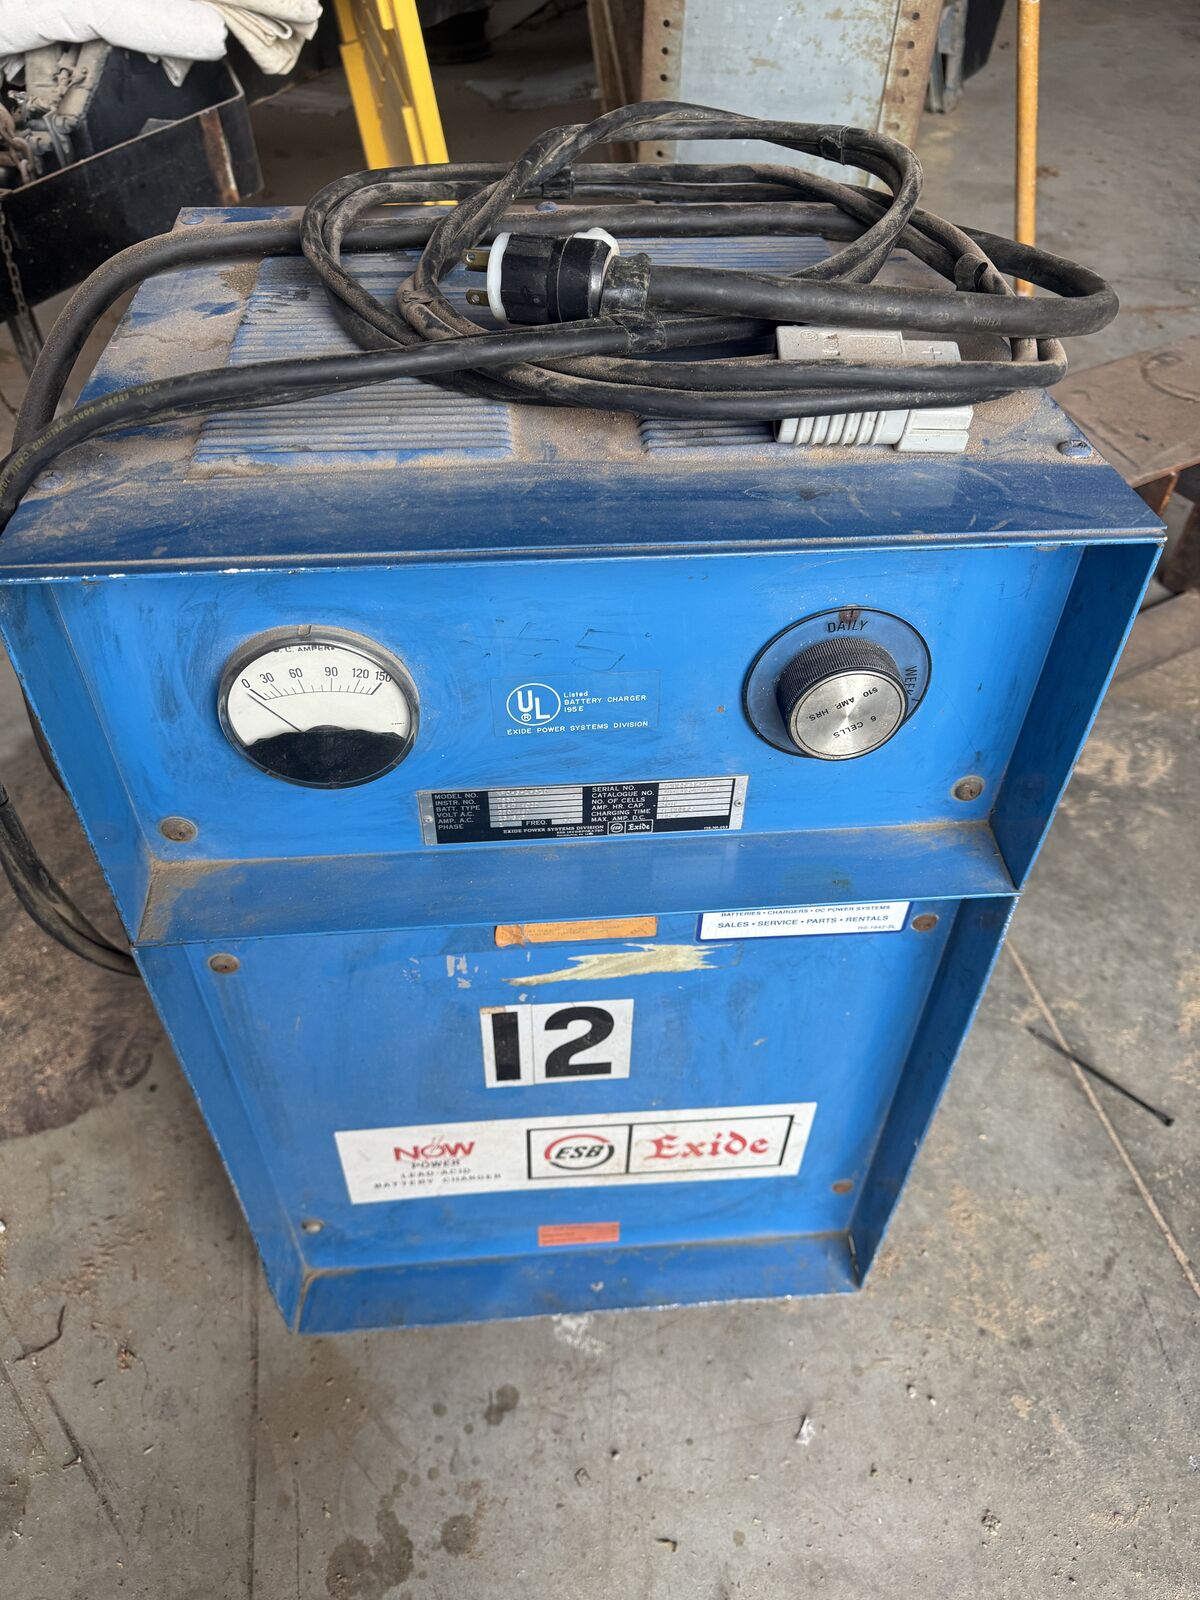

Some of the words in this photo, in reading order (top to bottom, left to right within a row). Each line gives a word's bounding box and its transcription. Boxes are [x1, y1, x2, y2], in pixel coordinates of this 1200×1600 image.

[827, 619, 869, 633] DAILY
[259, 672, 275, 684] 30
[288, 667, 303, 678] 60
[324, 666, 339, 677] 90
[352, 667, 370, 679] 120
[375, 671, 392, 683] 150
[241, 678, 251, 689] 0
[516, 690, 551, 720] UL
[564, 697, 602, 705] BATTERY
[607, 694, 647, 703] CHARGER
[835, 696, 855, 710] AMP.
[806, 709, 830, 722] HRS.
[507, 728, 532, 736] EXIDE
[536, 726, 566, 734] POWER
[570, 723, 609, 731] SYSTEMS
[613, 720, 649, 729] DIVISION
[833, 722, 864, 738] CELLS
[434, 792, 463, 800] MODEL
[592, 791, 639, 799] CATALOGUE
[526, 819, 548, 827] FREQ.
[718, 921, 749, 929] SALES
[757, 919, 798, 927] SERVICE
[806, 917, 838, 925] PARTS
[845, 914, 889, 923] RENTALS
[491, 1006, 614, 1081] 12
[393, 1139, 476, 1162] NOW
[553, 1143, 604, 1160] ESB
[645, 1132, 770, 1160] Exide
